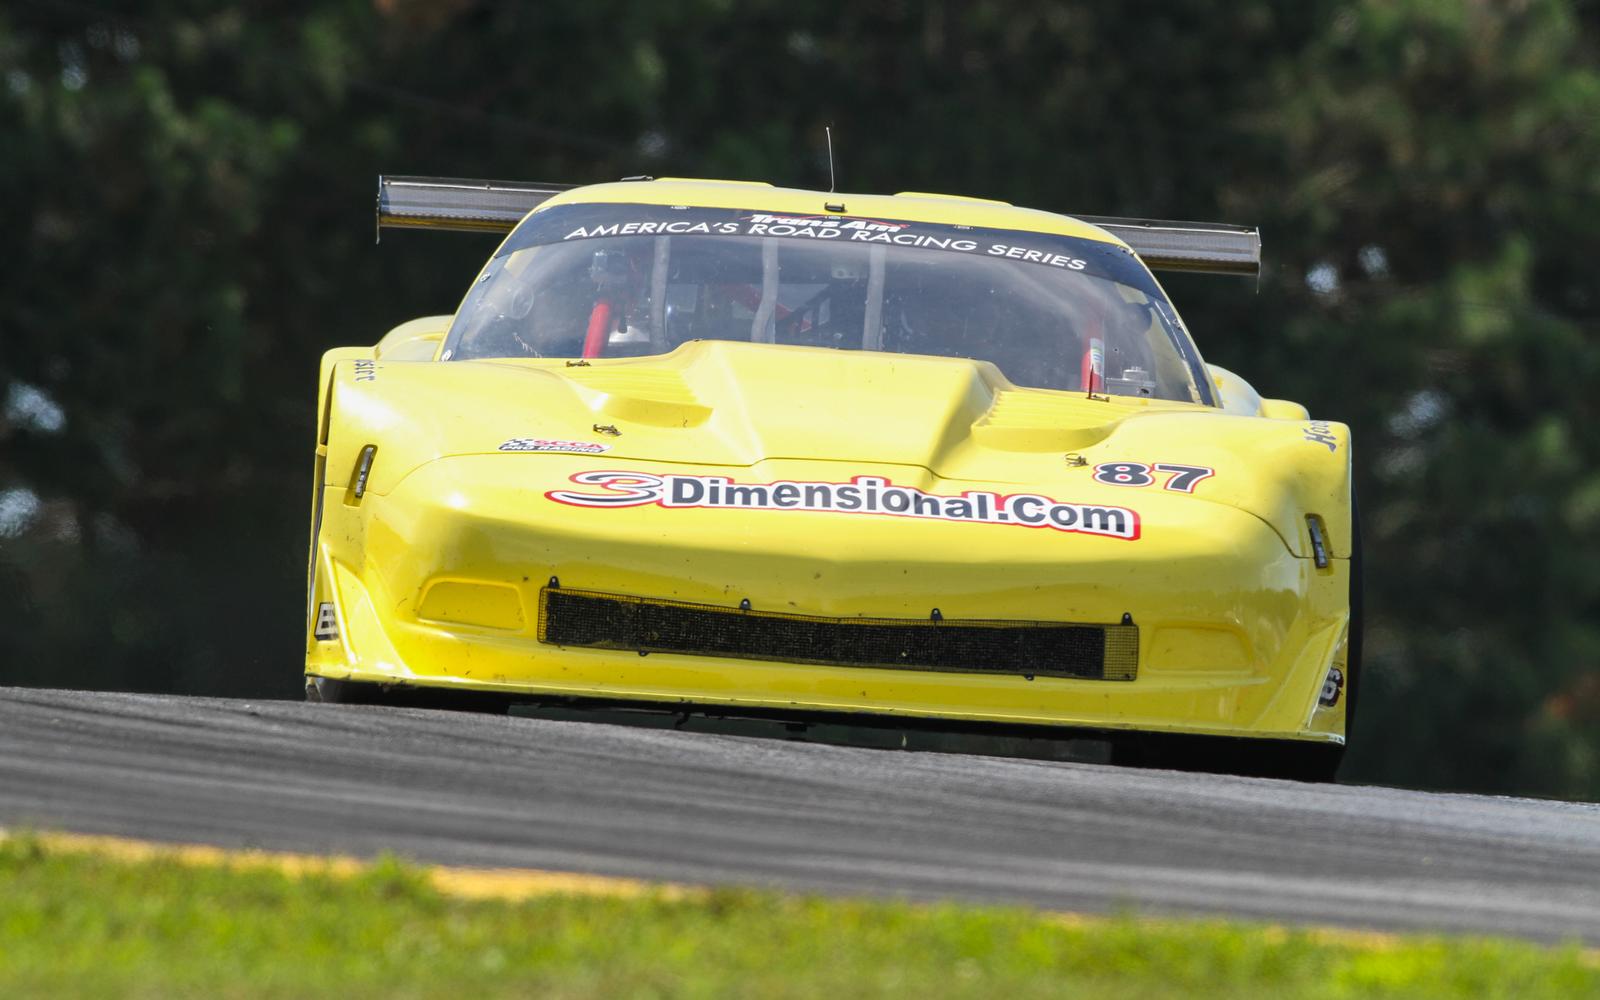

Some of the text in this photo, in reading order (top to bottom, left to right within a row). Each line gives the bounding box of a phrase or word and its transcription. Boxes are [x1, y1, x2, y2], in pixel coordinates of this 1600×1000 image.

[749, 214, 901, 233] Trans Am
[563, 221, 1087, 270] AMERICA'S ROAD RACING SERIES
[1093, 462, 1215, 493] 87
